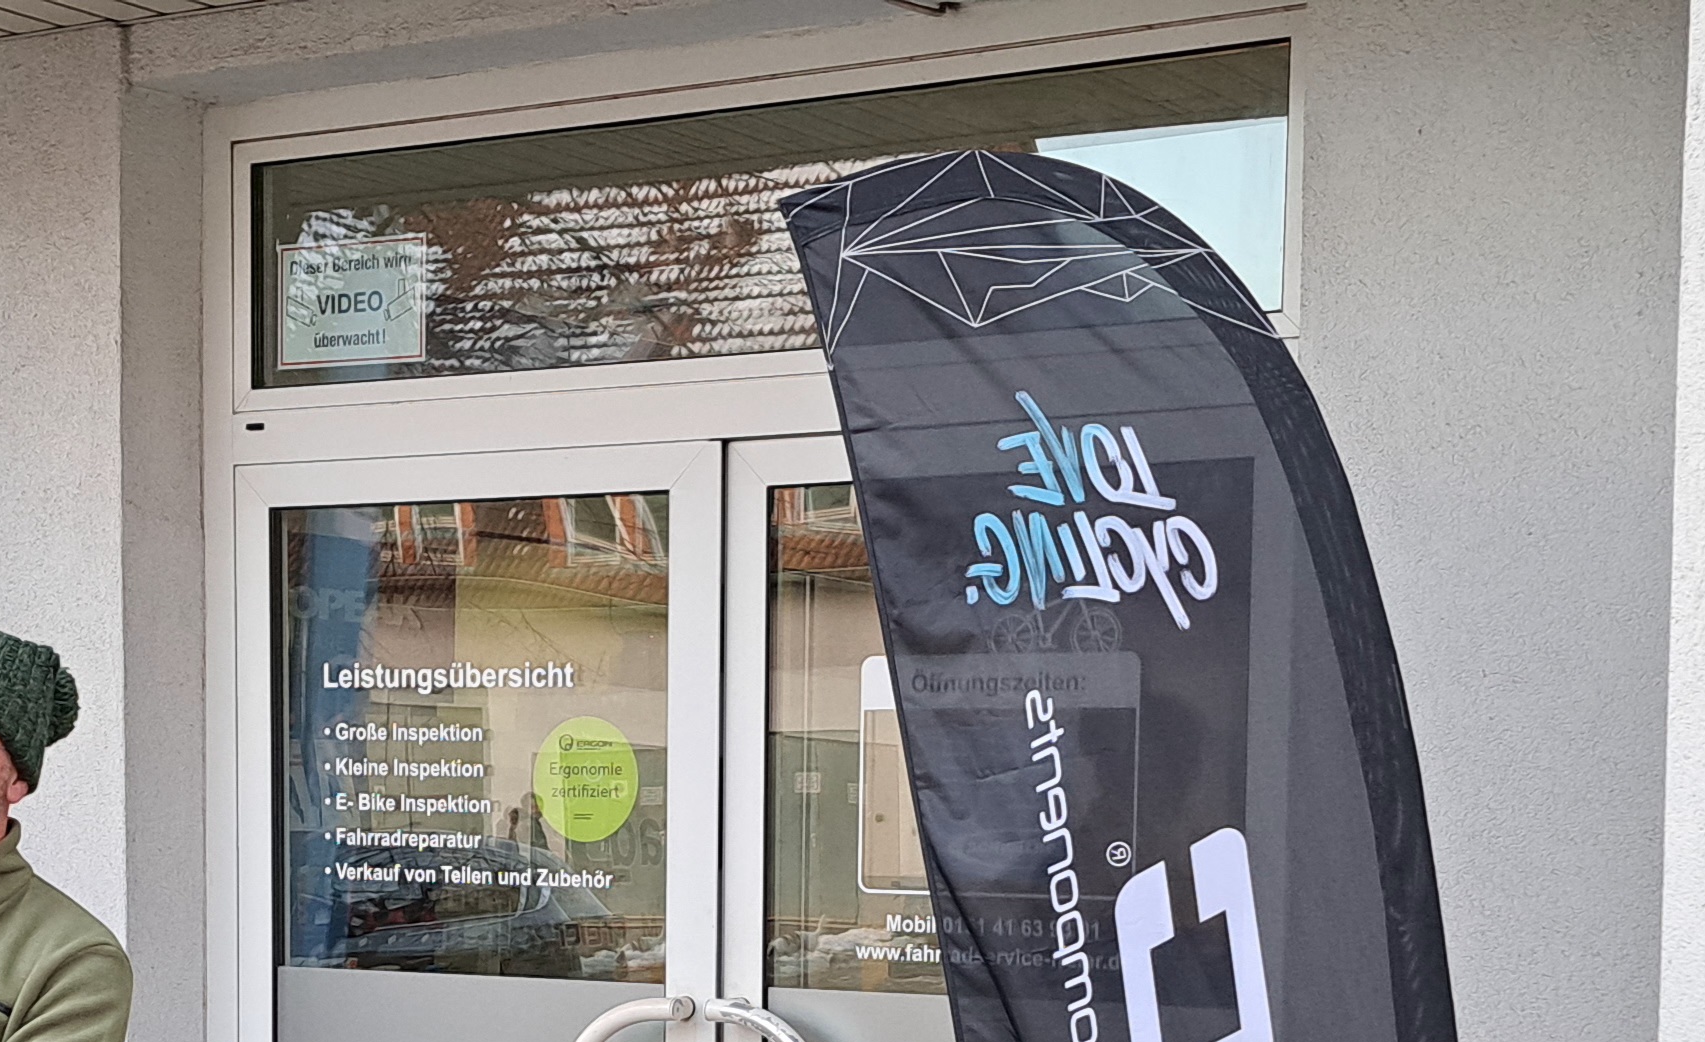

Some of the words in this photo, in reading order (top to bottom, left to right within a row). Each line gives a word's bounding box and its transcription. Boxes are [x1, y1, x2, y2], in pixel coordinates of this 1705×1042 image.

[332, 253, 380, 273] Bereich
[316, 291, 383, 315] VIDEO
[314, 328, 387, 349] überwacht!
[323, 662, 574, 694] Leistungsübersicht
[335, 723, 387, 741] Große
[392, 723, 483, 746] Inspektion
[335, 758, 389, 776] Kleine
[393, 759, 484, 780] Inspektion
[550, 762, 623, 779] Ergonomie
[552, 784, 620, 798] zertifiziert
[358, 793, 395, 811] Bike
[400, 794, 491, 816] Inspektion
[335, 827, 481, 851] Fahrradreparatur
[335, 862, 401, 882] Verkauf
[405, 868, 436, 883] von
[441, 865, 493, 885] Teilen
[498, 868, 531, 886] und
[536, 869, 614, 889] Zubehör
[886, 914, 936, 933] Mobil
